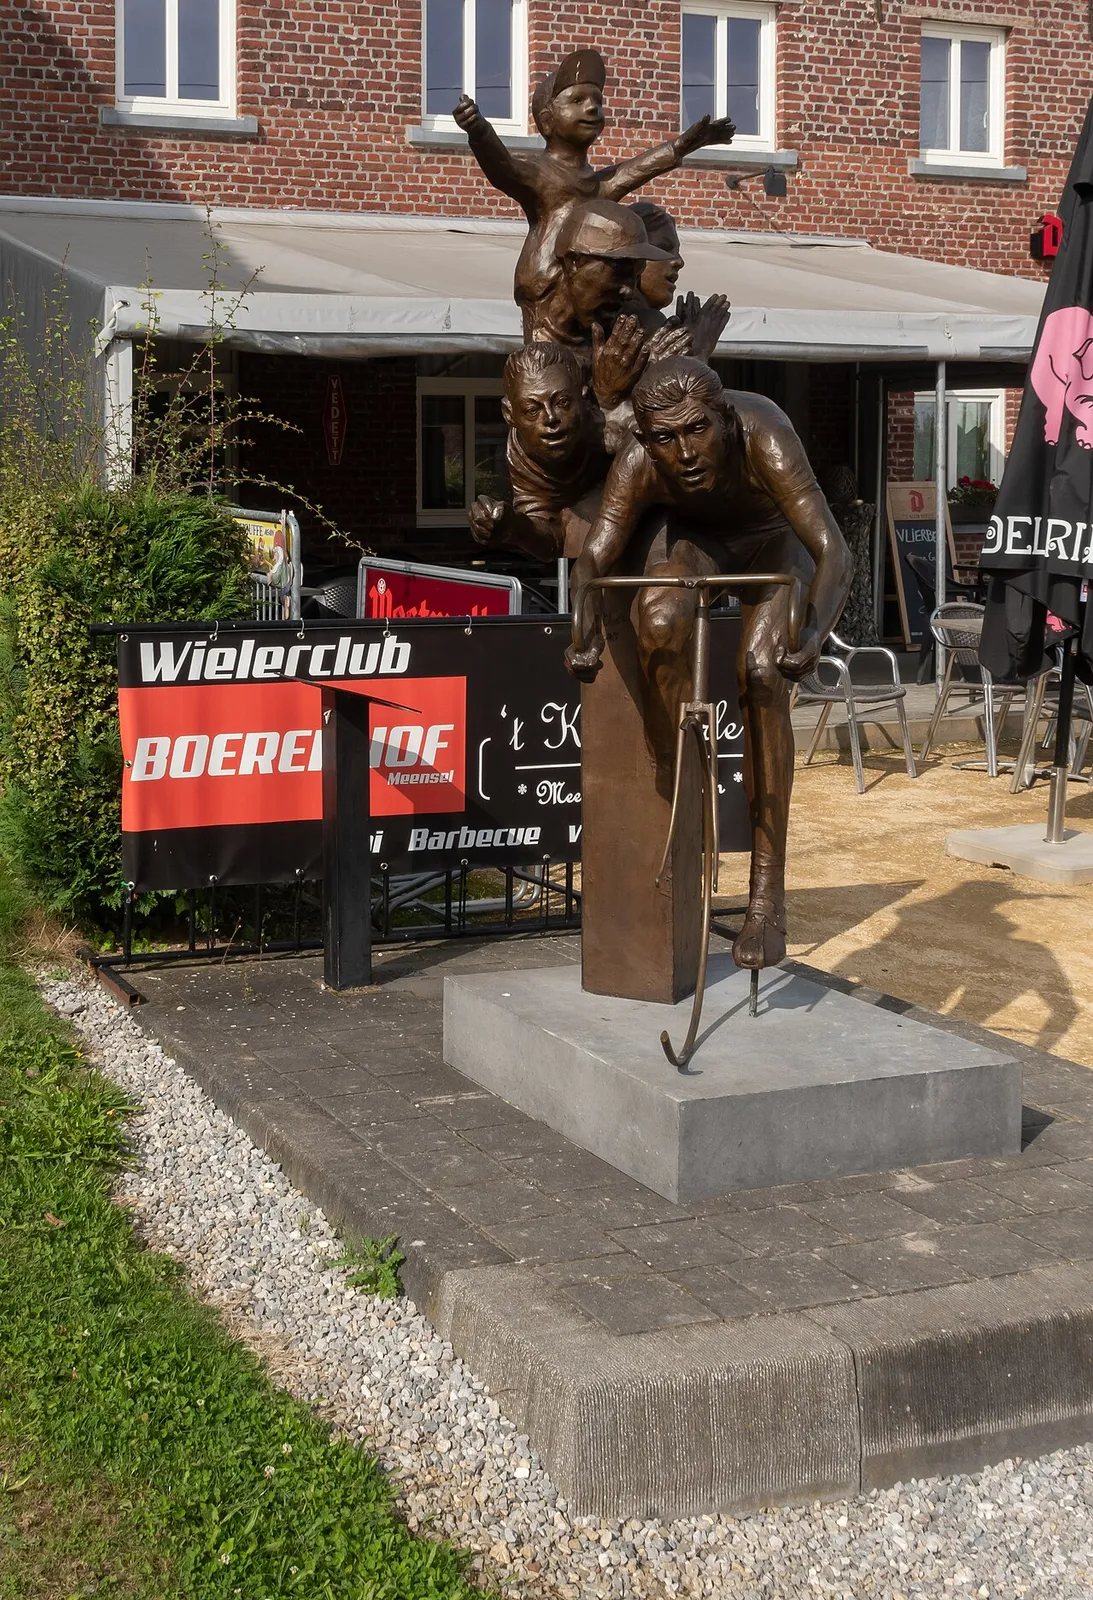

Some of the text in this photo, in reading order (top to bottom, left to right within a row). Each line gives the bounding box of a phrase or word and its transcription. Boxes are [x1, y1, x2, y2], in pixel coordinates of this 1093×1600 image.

[331, 378, 340, 461] VEDETT
[140, 635, 412, 683] Wielerclub
[387, 769, 455, 786] Meensel
[408, 825, 542, 852] Barbecue
